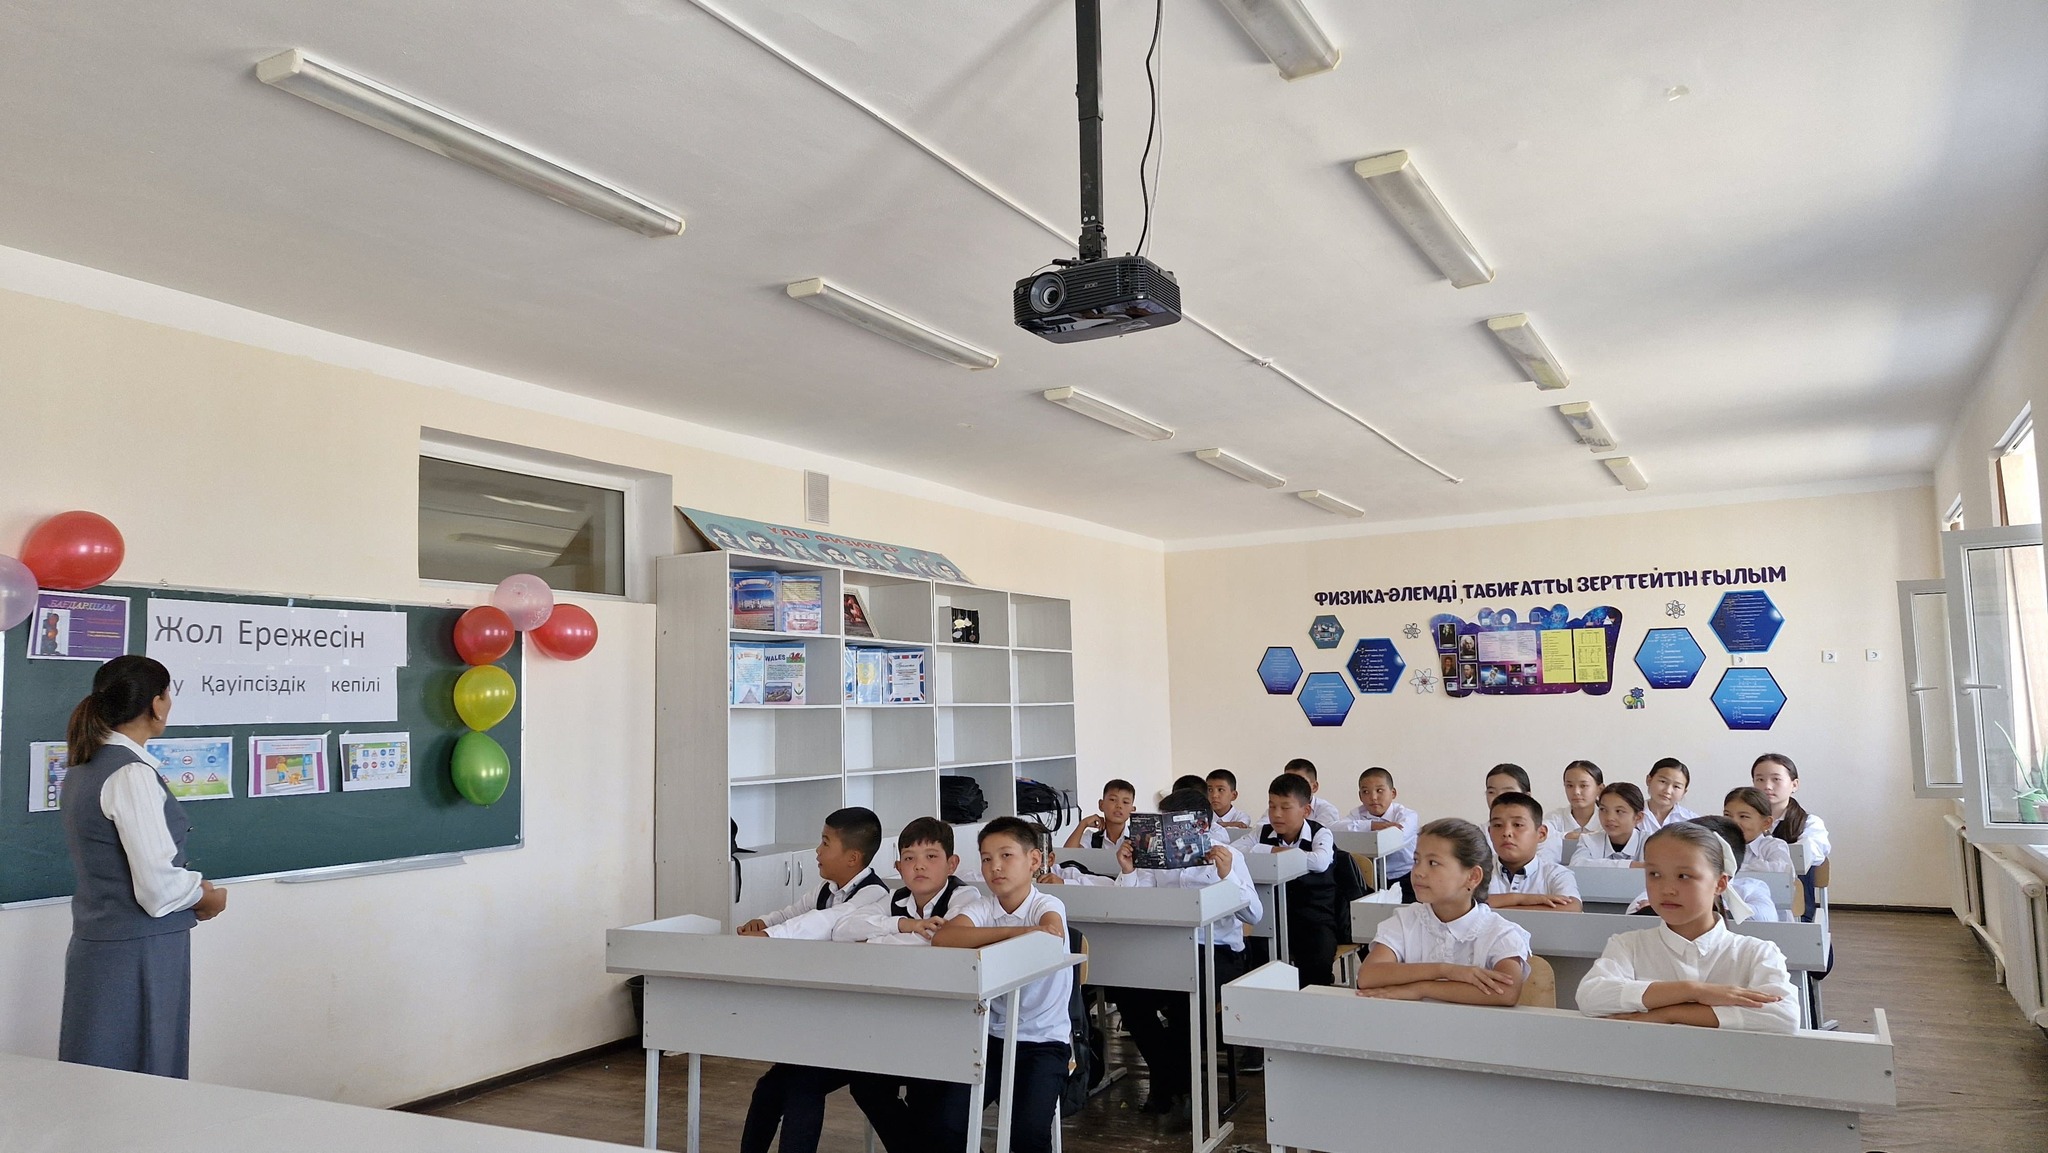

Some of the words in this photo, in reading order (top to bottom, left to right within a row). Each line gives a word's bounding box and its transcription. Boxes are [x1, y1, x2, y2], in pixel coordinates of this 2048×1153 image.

[815, 535, 899, 552] ФИЗИКТЕР
[1463, 577, 1574, 599] ТАБИҒАТТЫ
[1576, 567, 1698, 593] ЗЕРТТЕЙТІН
[1701, 565, 1787, 587] ҒЫЛЫМ
[154, 615, 222, 644] Жол
[238, 619, 364, 652] Ережесін
[202, 675, 306, 696] Қауіпсіздік
[331, 676, 380, 693] кепілі
